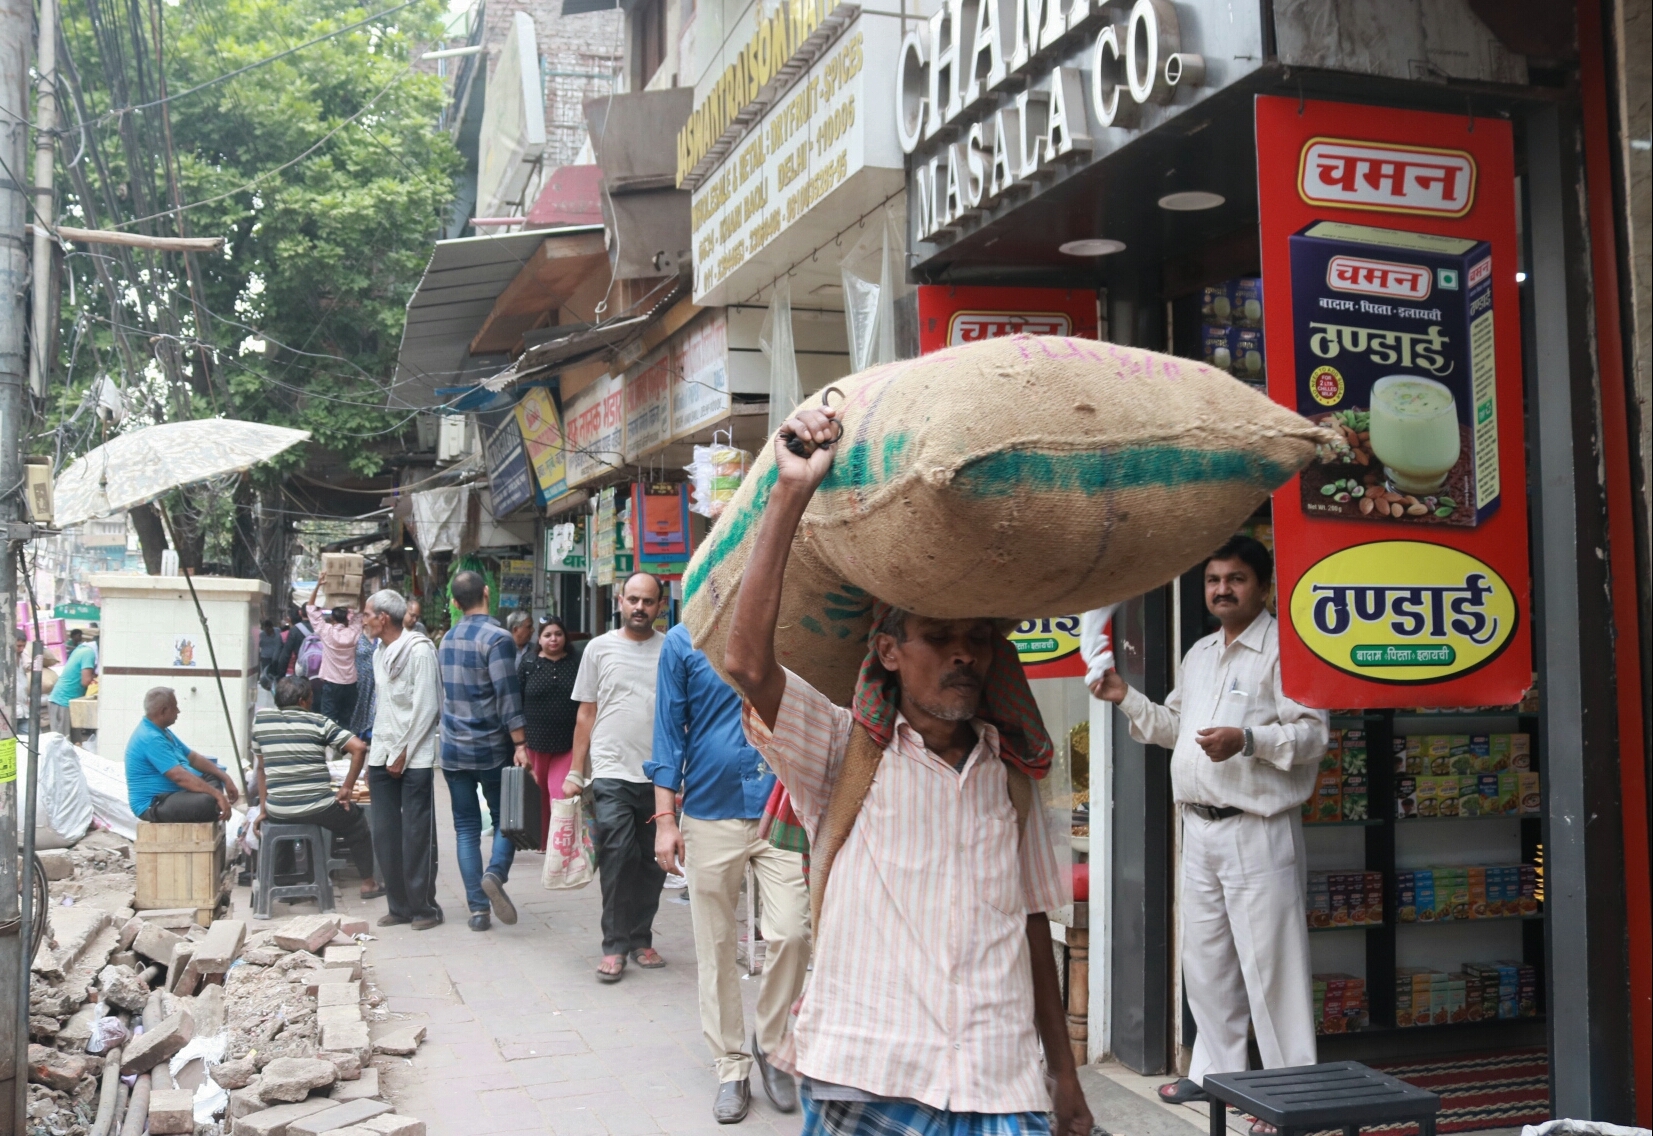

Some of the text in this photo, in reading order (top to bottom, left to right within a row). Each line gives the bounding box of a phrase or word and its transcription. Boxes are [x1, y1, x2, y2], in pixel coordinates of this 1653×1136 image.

[916, 0, 1183, 243] MASALA CO.
[1316, 152, 1463, 201] चमन
[720, 201, 742, 246] KHARI
[744, 176, 768, 223] BAOLI
[1336, 263, 1423, 292] चमन
[1319, 297, 1442, 321] बादाम पिस्ता इलायची
[1309, 321, 1454, 376] ठण्डाई
[1311, 573, 1498, 645] ठण्डाई
[1356, 645, 1450, 662] बादाम पिस्ता इलायची
